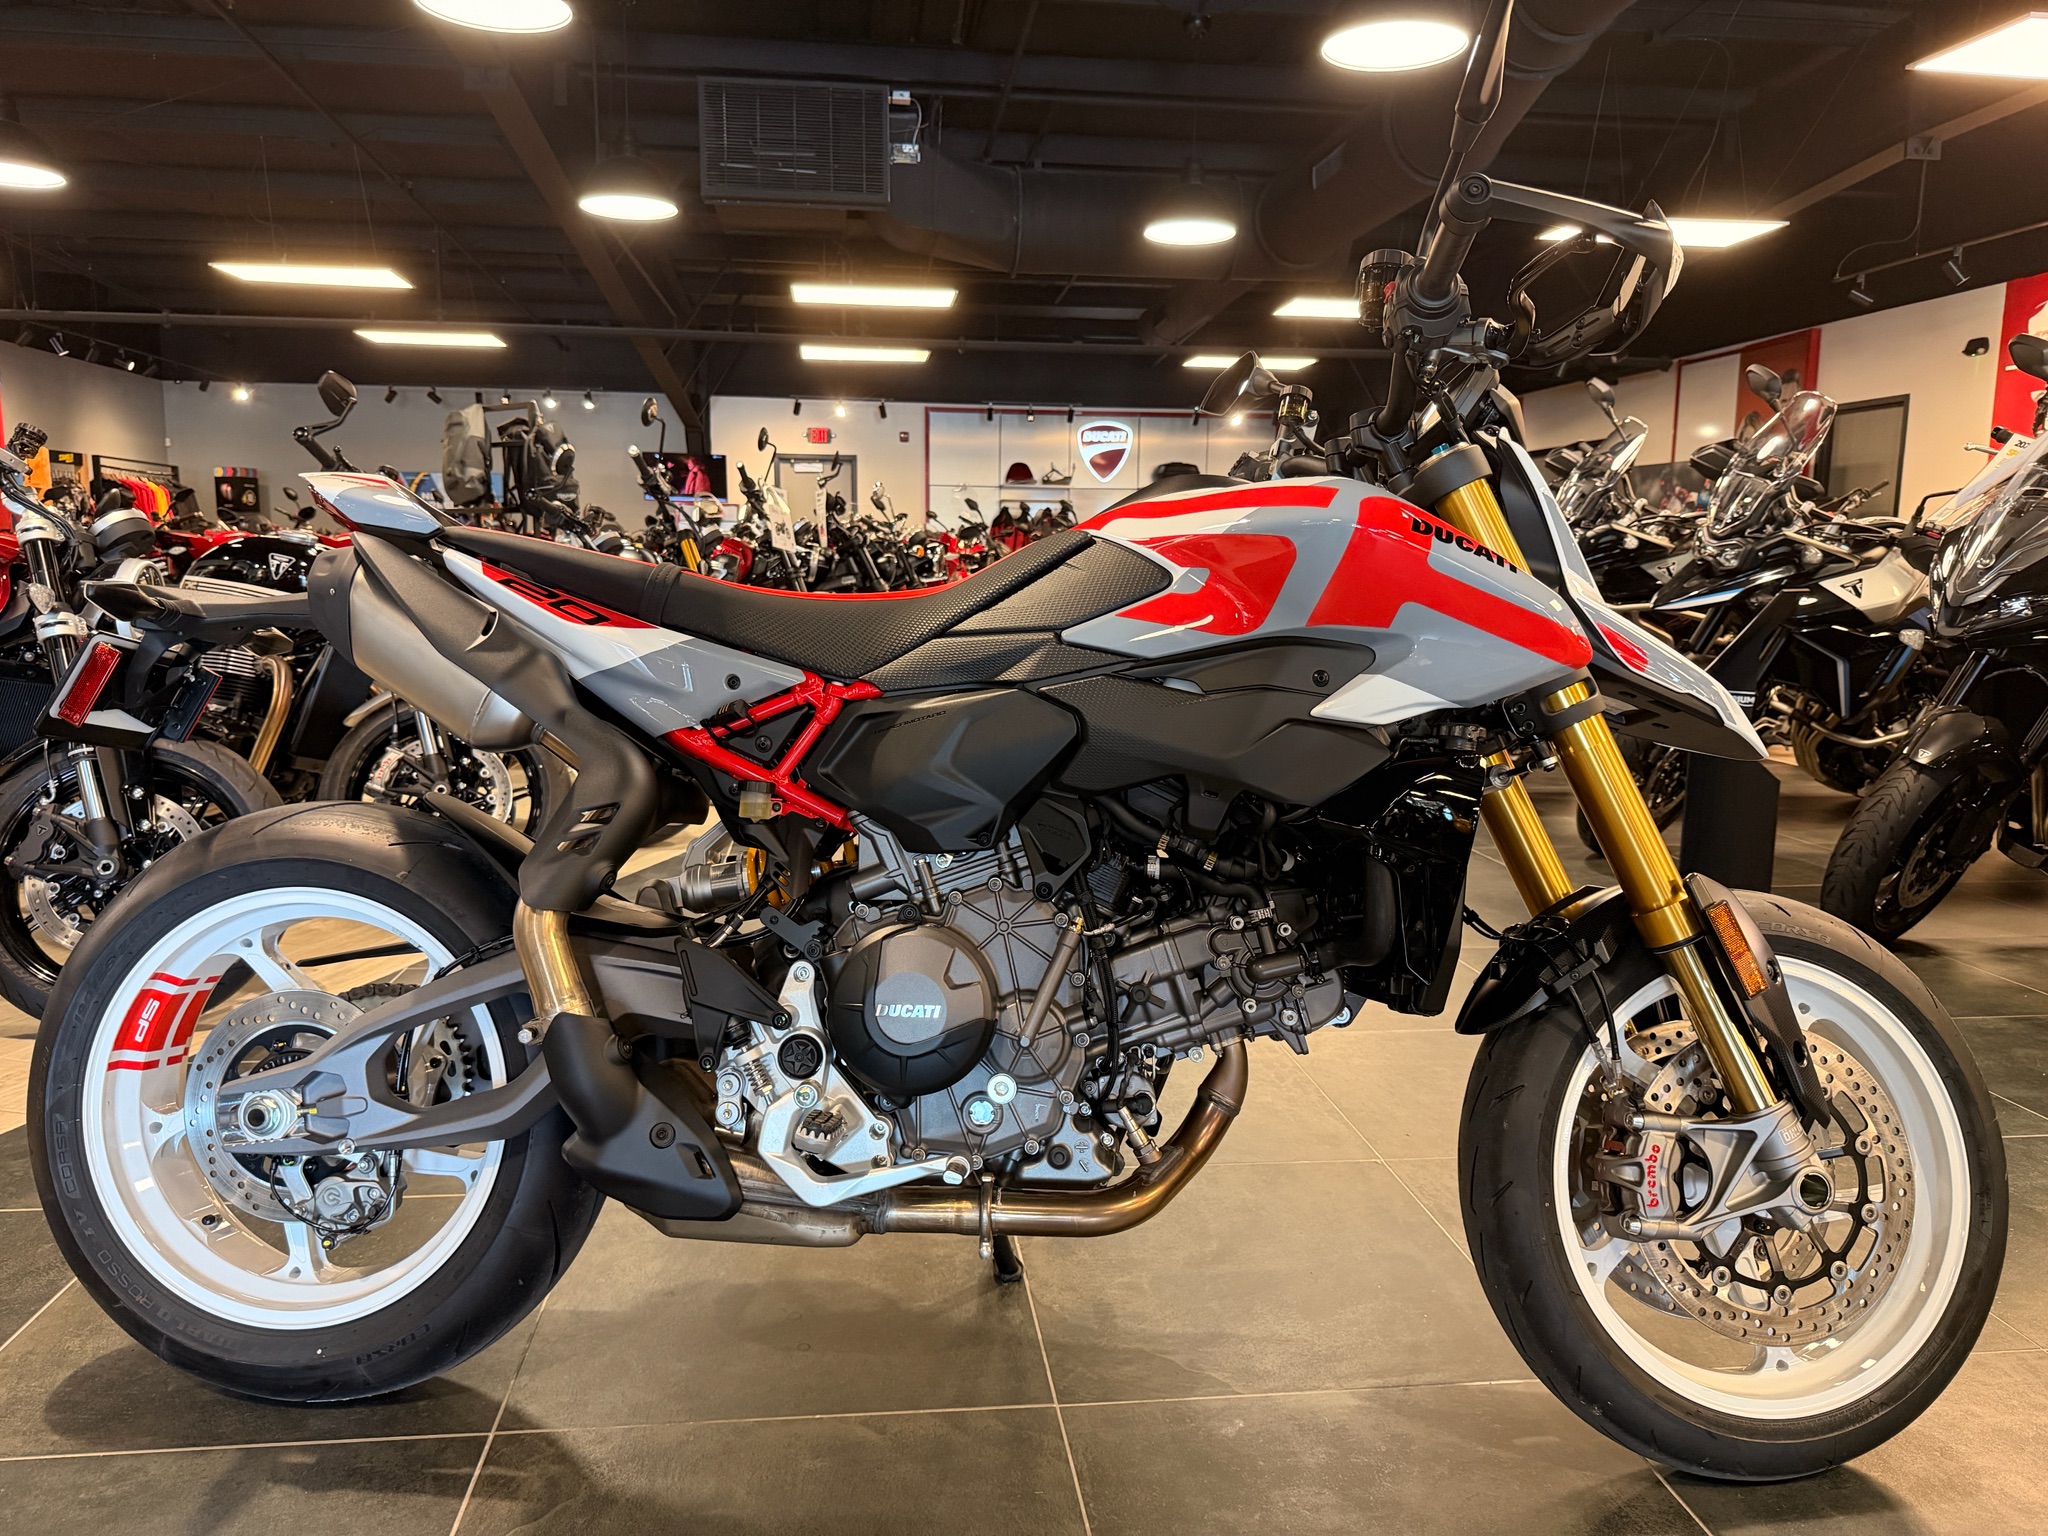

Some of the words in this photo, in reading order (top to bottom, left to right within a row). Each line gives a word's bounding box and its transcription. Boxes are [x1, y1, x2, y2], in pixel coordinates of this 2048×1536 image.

[1082, 430, 1128, 443] DUCATI
[1411, 517, 1518, 573] DUCATI
[1758, 921, 1831, 944] CORSA
[134, 998, 160, 1043] SP
[875, 1004, 942, 1018] DUCATI
[55, 1120, 77, 1194] CORSA
[1645, 1144, 1661, 1208] brembo
[73, 1208, 96, 1238] IV
[97, 1250, 155, 1309] ROSSO
